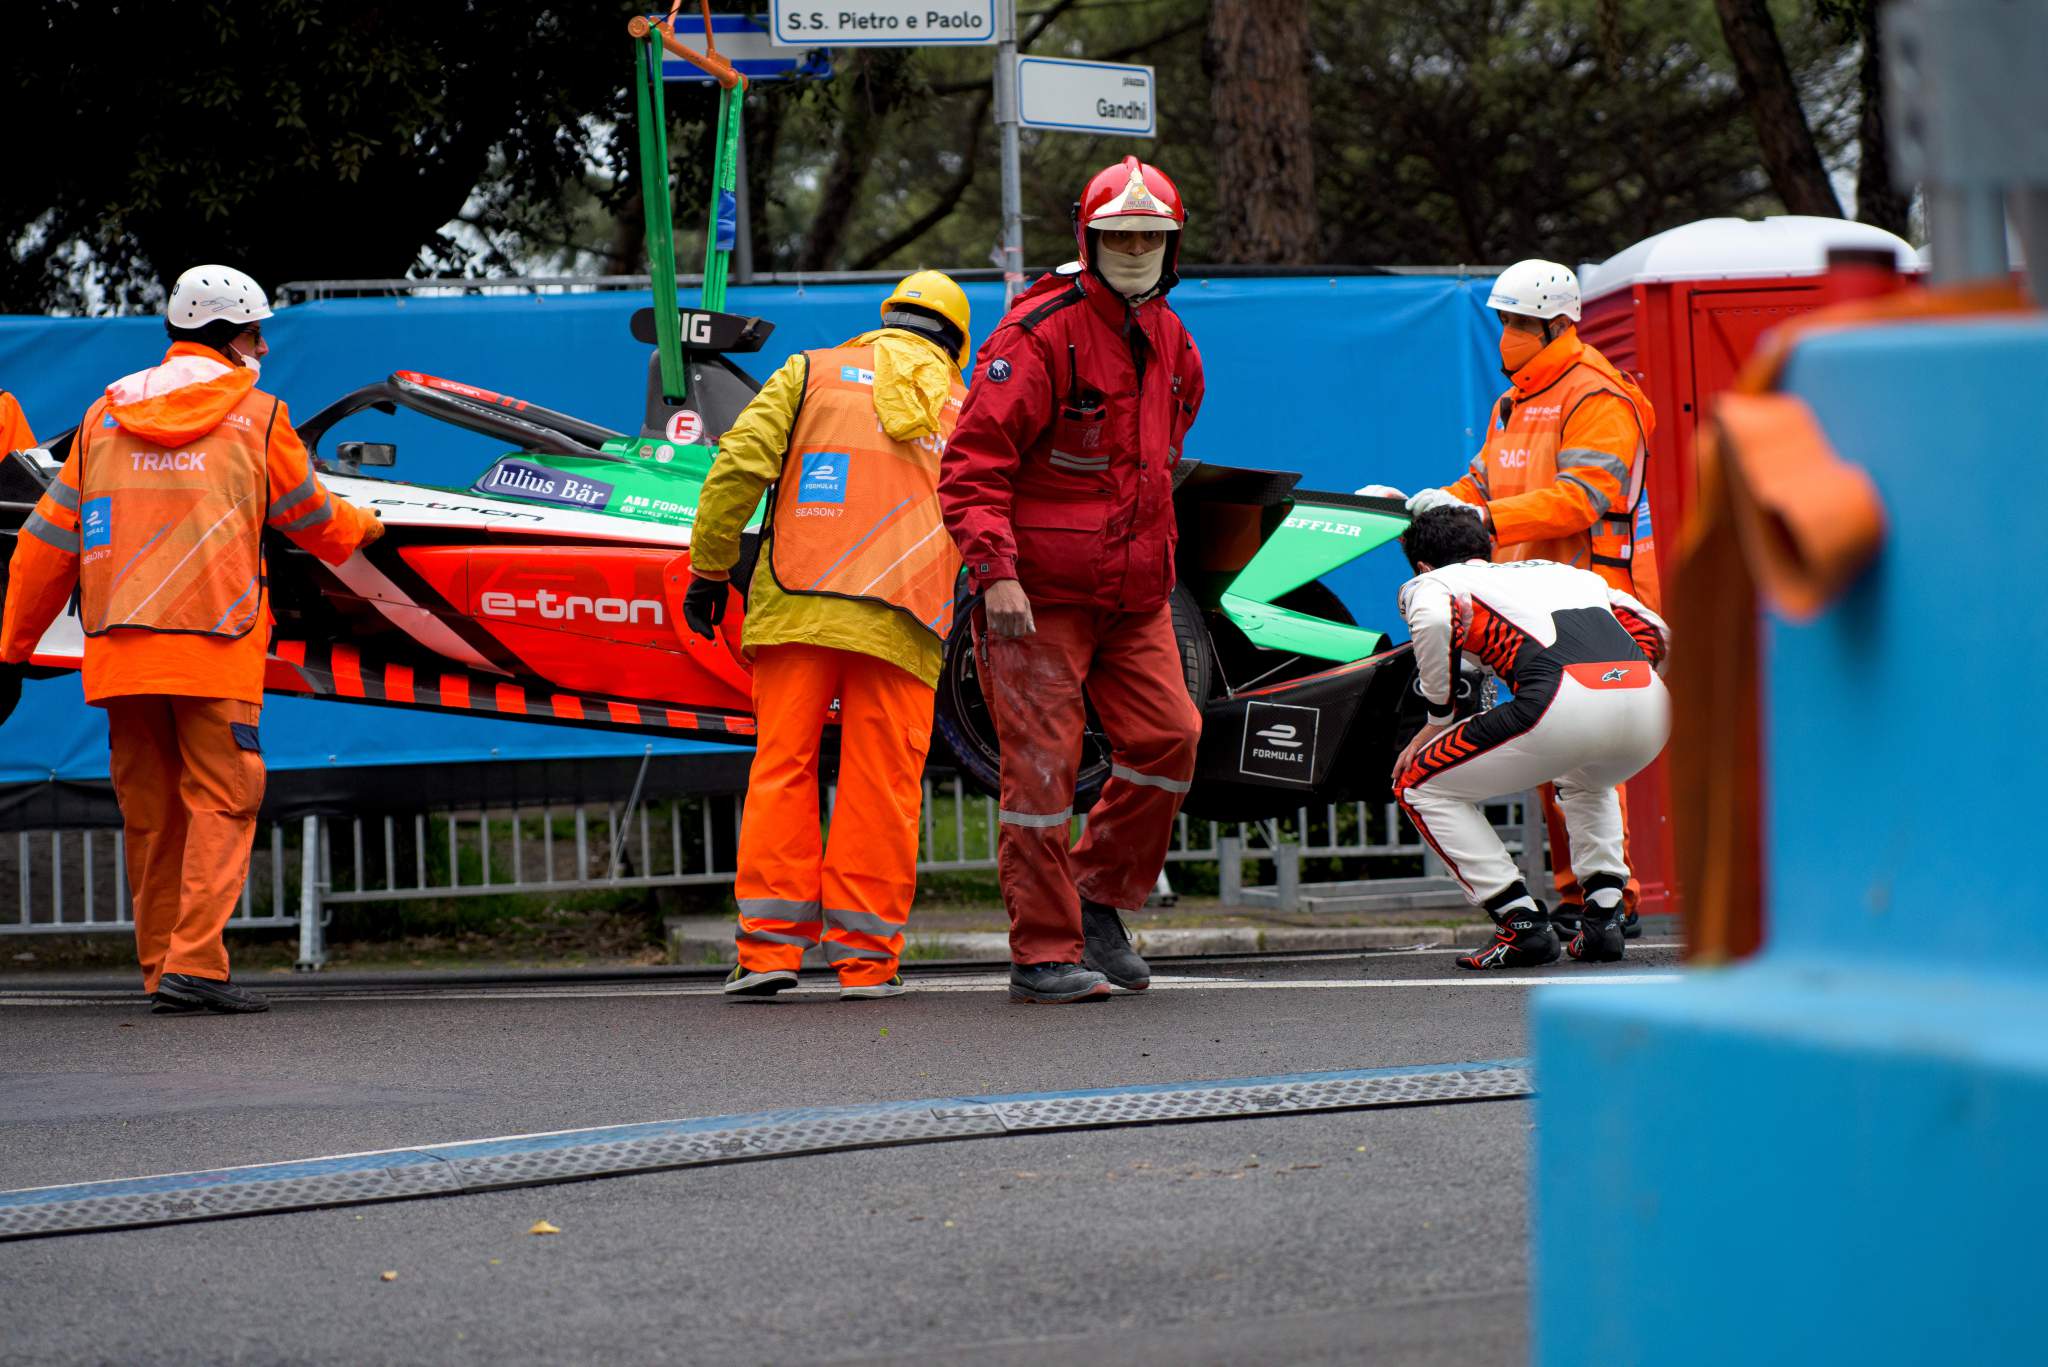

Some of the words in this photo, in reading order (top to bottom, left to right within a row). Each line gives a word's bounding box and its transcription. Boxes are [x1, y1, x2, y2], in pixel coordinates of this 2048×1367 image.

[787, 12, 829, 30] S.S.
[839, 12, 899, 29] Pietro
[905, 16, 918, 28] e
[927, 11, 983, 28] Paolo
[1096, 98, 1147, 120] Gandhi
[679, 312, 712, 344] IG
[674, 416, 695, 440] E
[131, 452, 207, 471] TRACK
[490, 463, 556, 496] Julius
[559, 480, 605, 506] Bär
[370, 499, 545, 522] e-tron
[623, 495, 650, 507] ABB
[795, 508, 835, 517] SEASON
[838, 509, 845, 517] 7
[481, 589, 663, 624] e-tron
[1252, 748, 1296, 761] FORMULA
[1297, 754, 1304, 762] E
